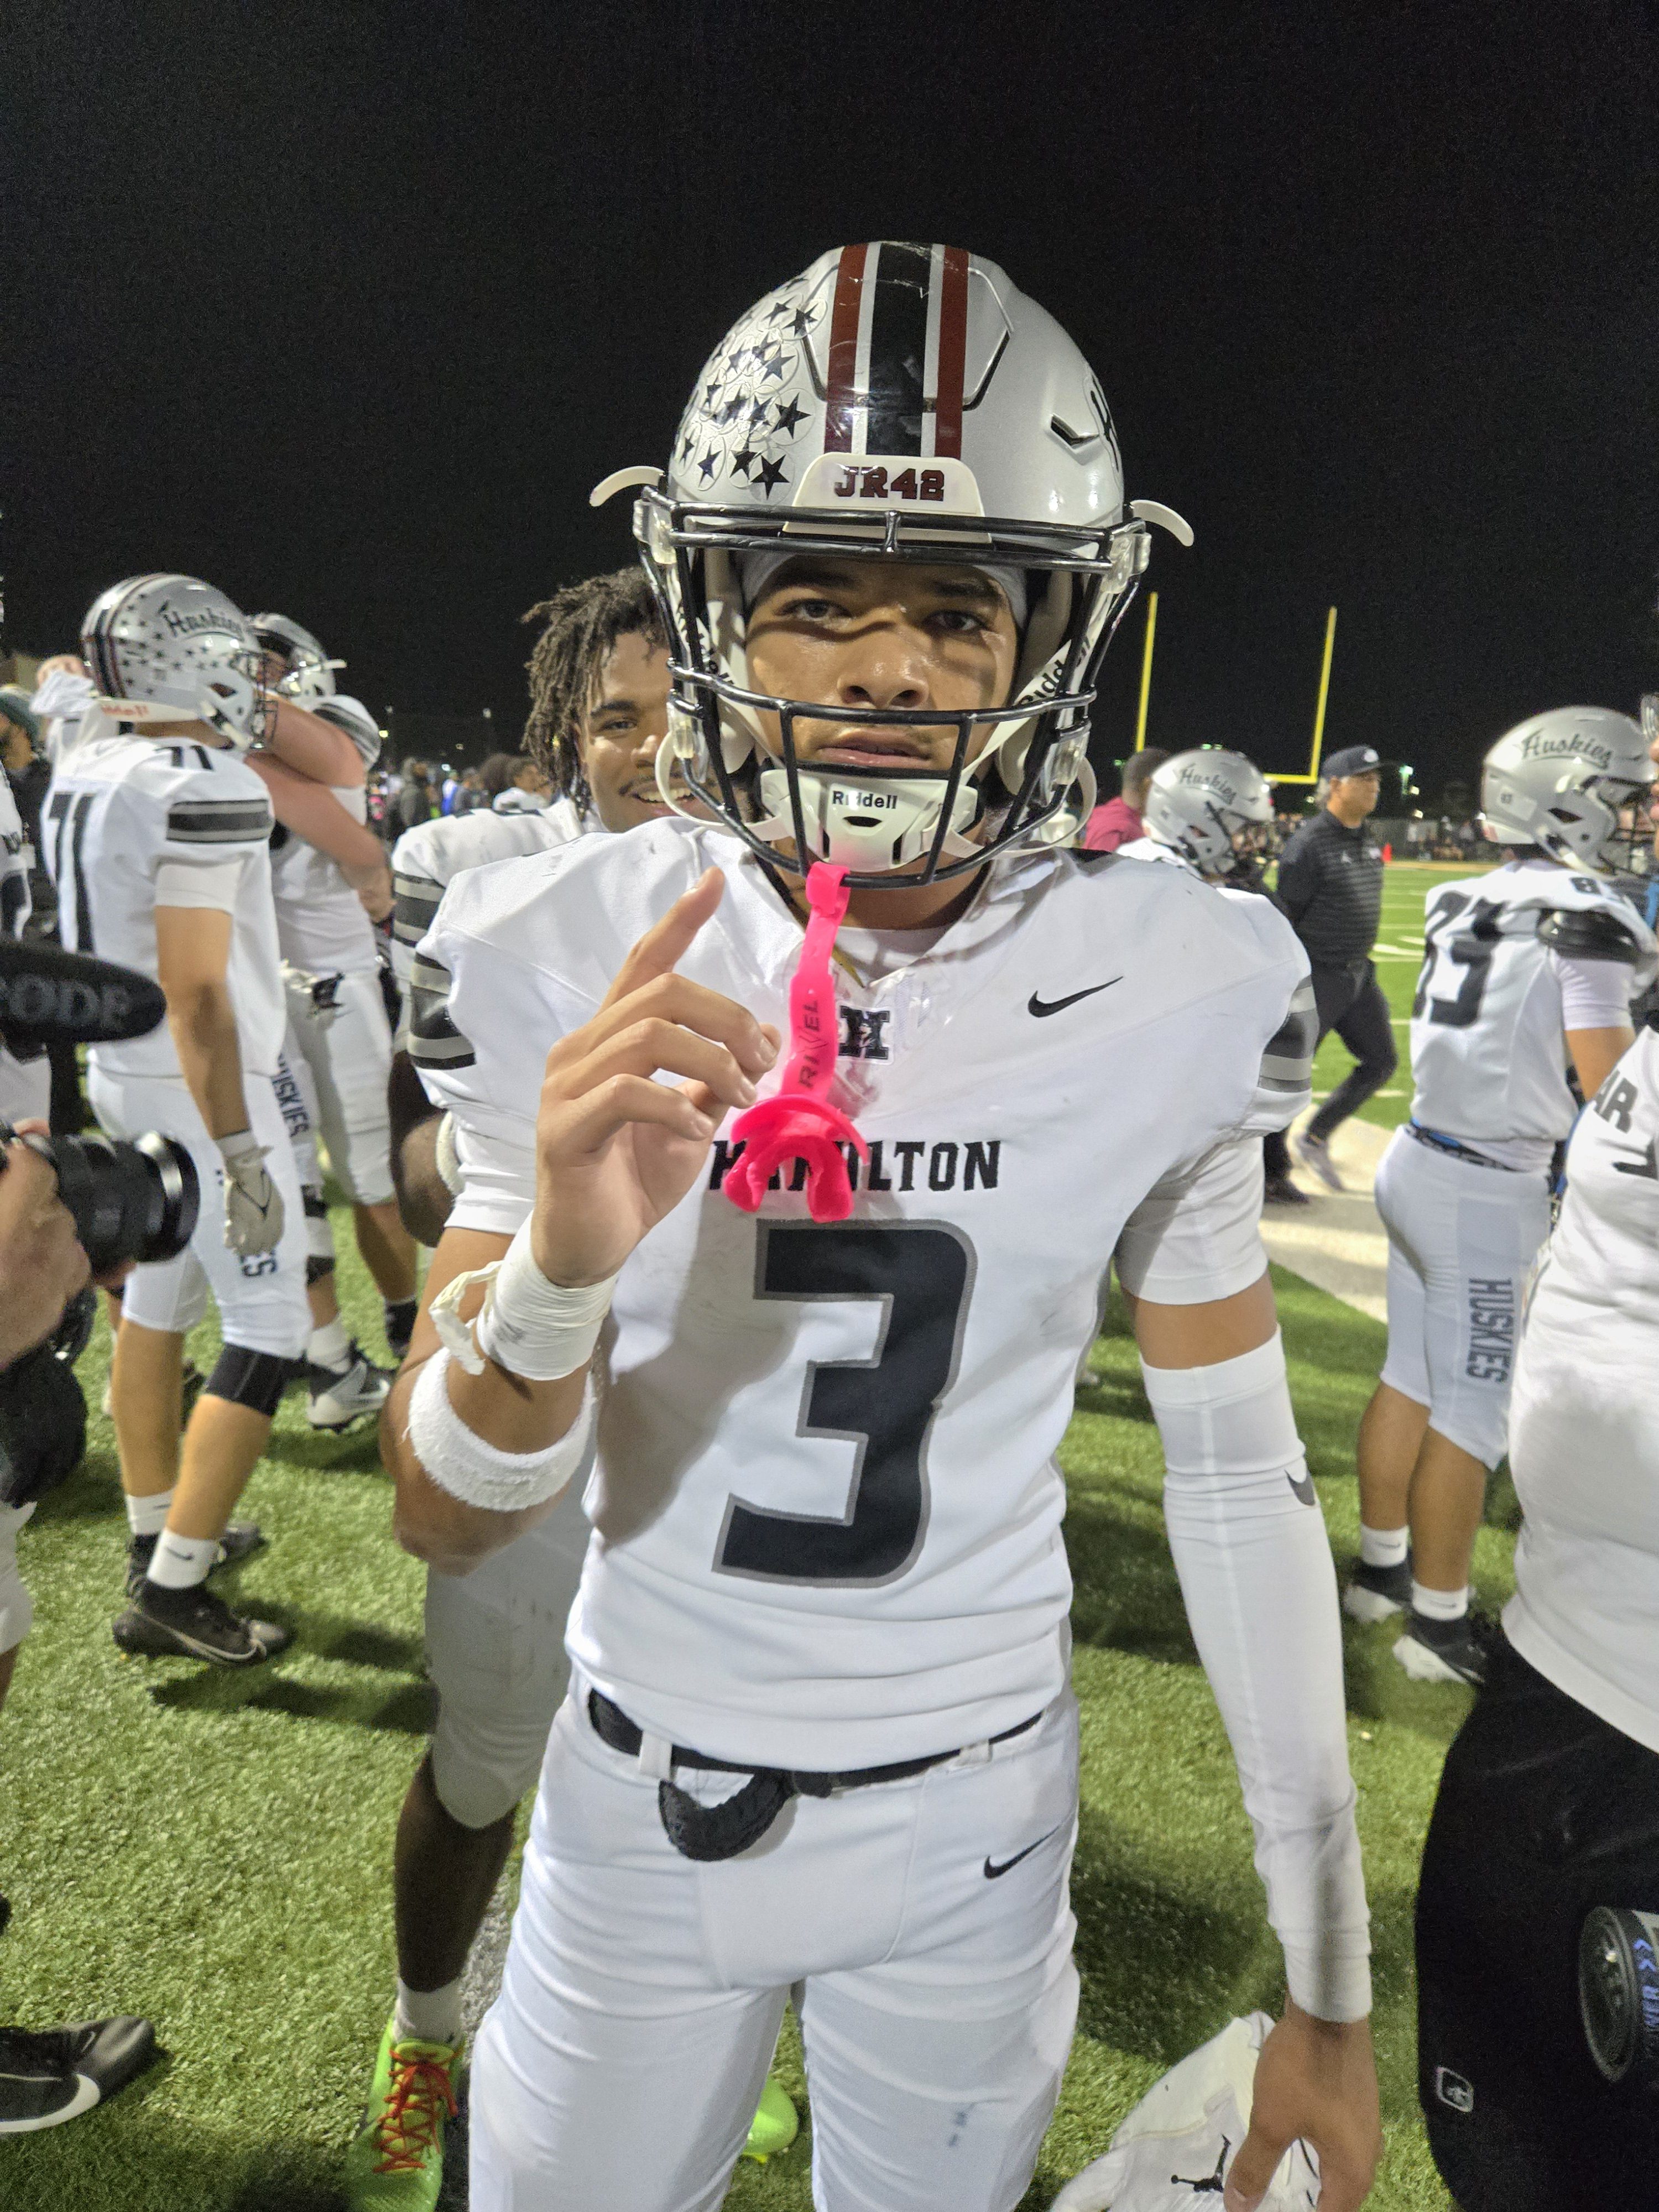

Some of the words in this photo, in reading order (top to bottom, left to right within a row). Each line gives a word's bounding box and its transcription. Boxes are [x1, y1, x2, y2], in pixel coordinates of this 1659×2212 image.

[1519, 727, 1613, 770] Huskies
[0, 972, 134, 1031] ODE
[709, 1139, 1001, 1192] HILTON
[1466, 1277, 1515, 1383] HUSKIES
[711, 1218, 979, 1589] 3
